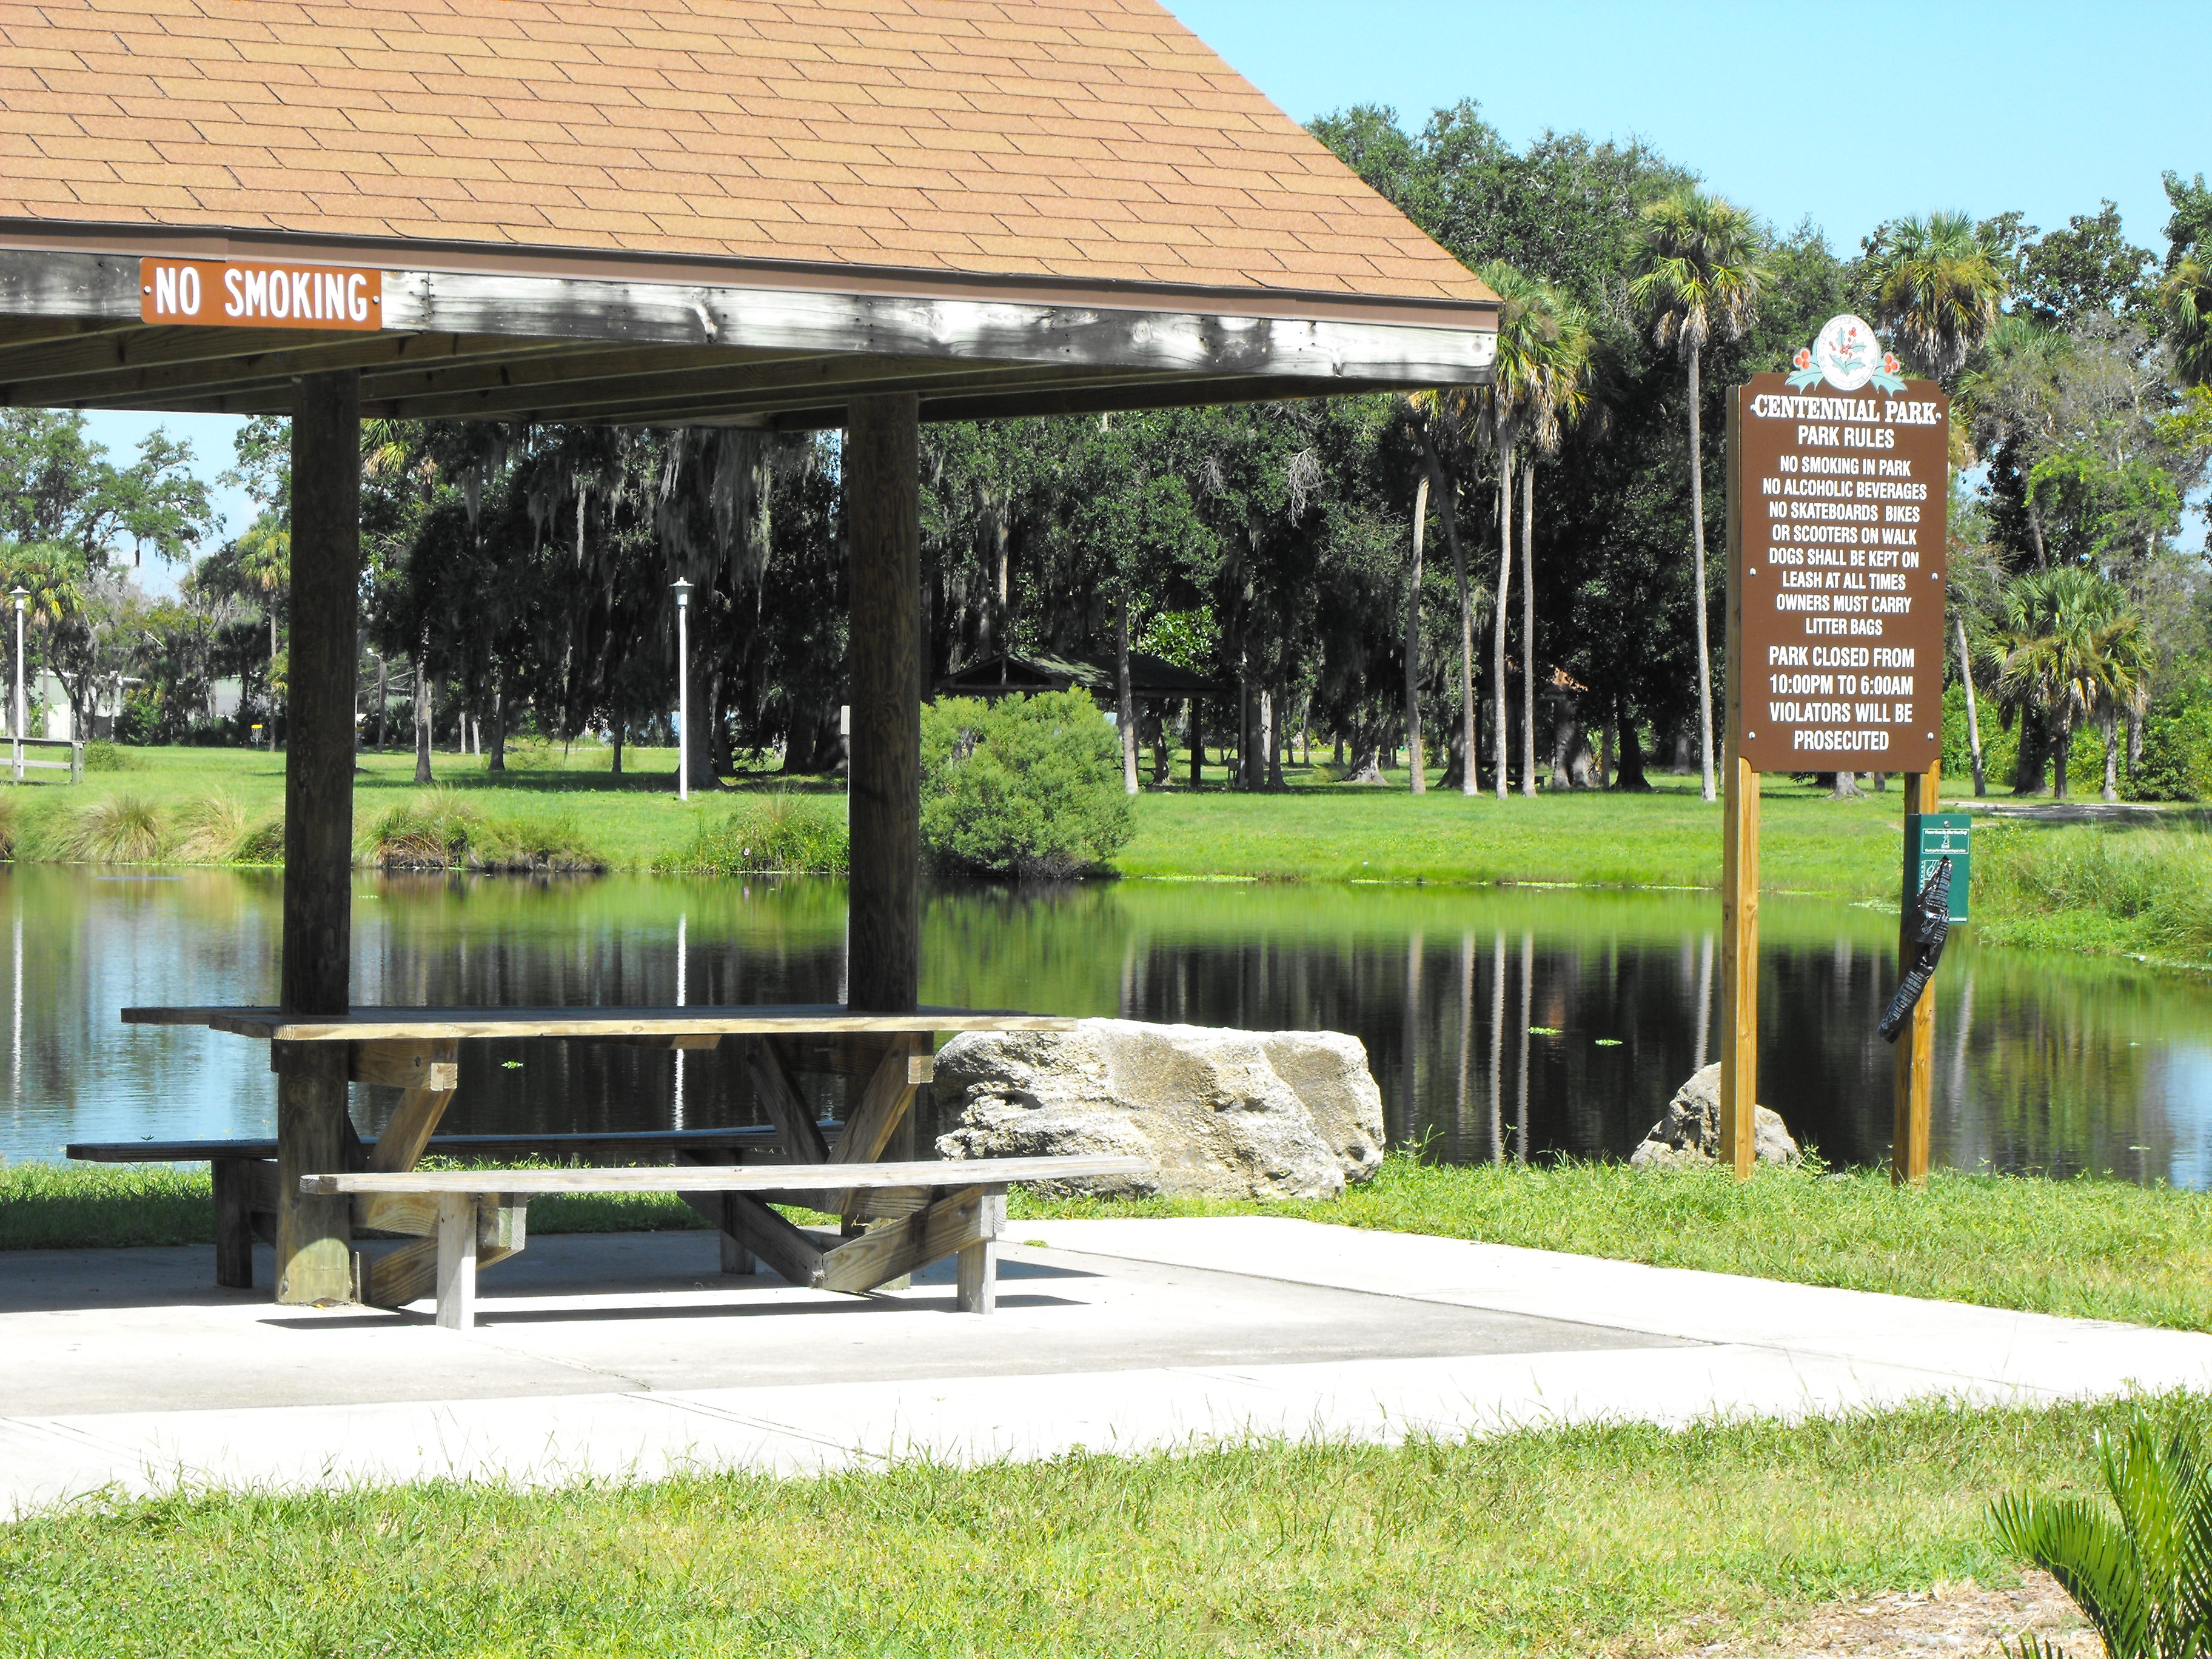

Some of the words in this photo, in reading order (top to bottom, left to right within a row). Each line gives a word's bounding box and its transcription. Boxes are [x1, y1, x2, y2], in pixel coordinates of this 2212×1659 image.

[156, 267, 200, 315] NO
[224, 268, 367, 321] SMOKING
[1754, 394, 1880, 422] CENTENNIAL
[1885, 401, 1937, 424] PARK
[1798, 424, 1840, 446] PARK
[1844, 426, 1895, 449] RULES
[1780, 455, 1798, 473] NO
[1801, 455, 1859, 475] SMOKING
[1862, 458, 1875, 475] IN
[1879, 459, 1911, 477] PARK
[1763, 477, 1781, 495] NO
[1783, 478, 1854, 498] ALCOHOLIC
[1856, 481, 1927, 500] BEVERAGES
[1769, 501, 1788, 518] NO
[1790, 501, 1879, 521] SKATEBOARDS
[1885, 505, 1920, 523] BIKES
[1772, 523, 1791, 541] OR
[1793, 525, 1858, 544] SCOOTERS
[1861, 527, 1879, 545] ON
[1882, 528, 1917, 546] WALK
[1769, 547, 1804, 565] DOGS
[1807, 548, 1847, 566] SHALL
[1850, 549, 1866, 567] BE
[1868, 550, 1900, 568] KEPT
[1902, 551, 1919, 568] ON
[1782, 571, 1822, 588] LEASH
[1825, 572, 1841, 589] AT
[1843, 572, 1866, 590] ALL
[1868, 572, 1906, 591] TIMES
[1776, 593, 1830, 612] OWNERS
[1833, 595, 1869, 612] MUST
[1871, 595, 1912, 614] CARRY
[1806, 617, 1848, 635] LITTER
[1850, 618, 1883, 636] BAGS
[1769, 645, 1809, 666] PARK
[1812, 646, 1869, 667] CLOSED
[1873, 648, 1915, 668] FROM
[1769, 674, 1833, 694] 10:00PM
[1837, 674, 1857, 695] TO
[1860, 675, 1914, 695] 6:00AM
[1769, 702, 1851, 723] VIOLATORS
[1854, 703, 1891, 723] WILL
[1895, 703, 1913, 723] BE
[1794, 729, 1889, 751] PROSECUTED
